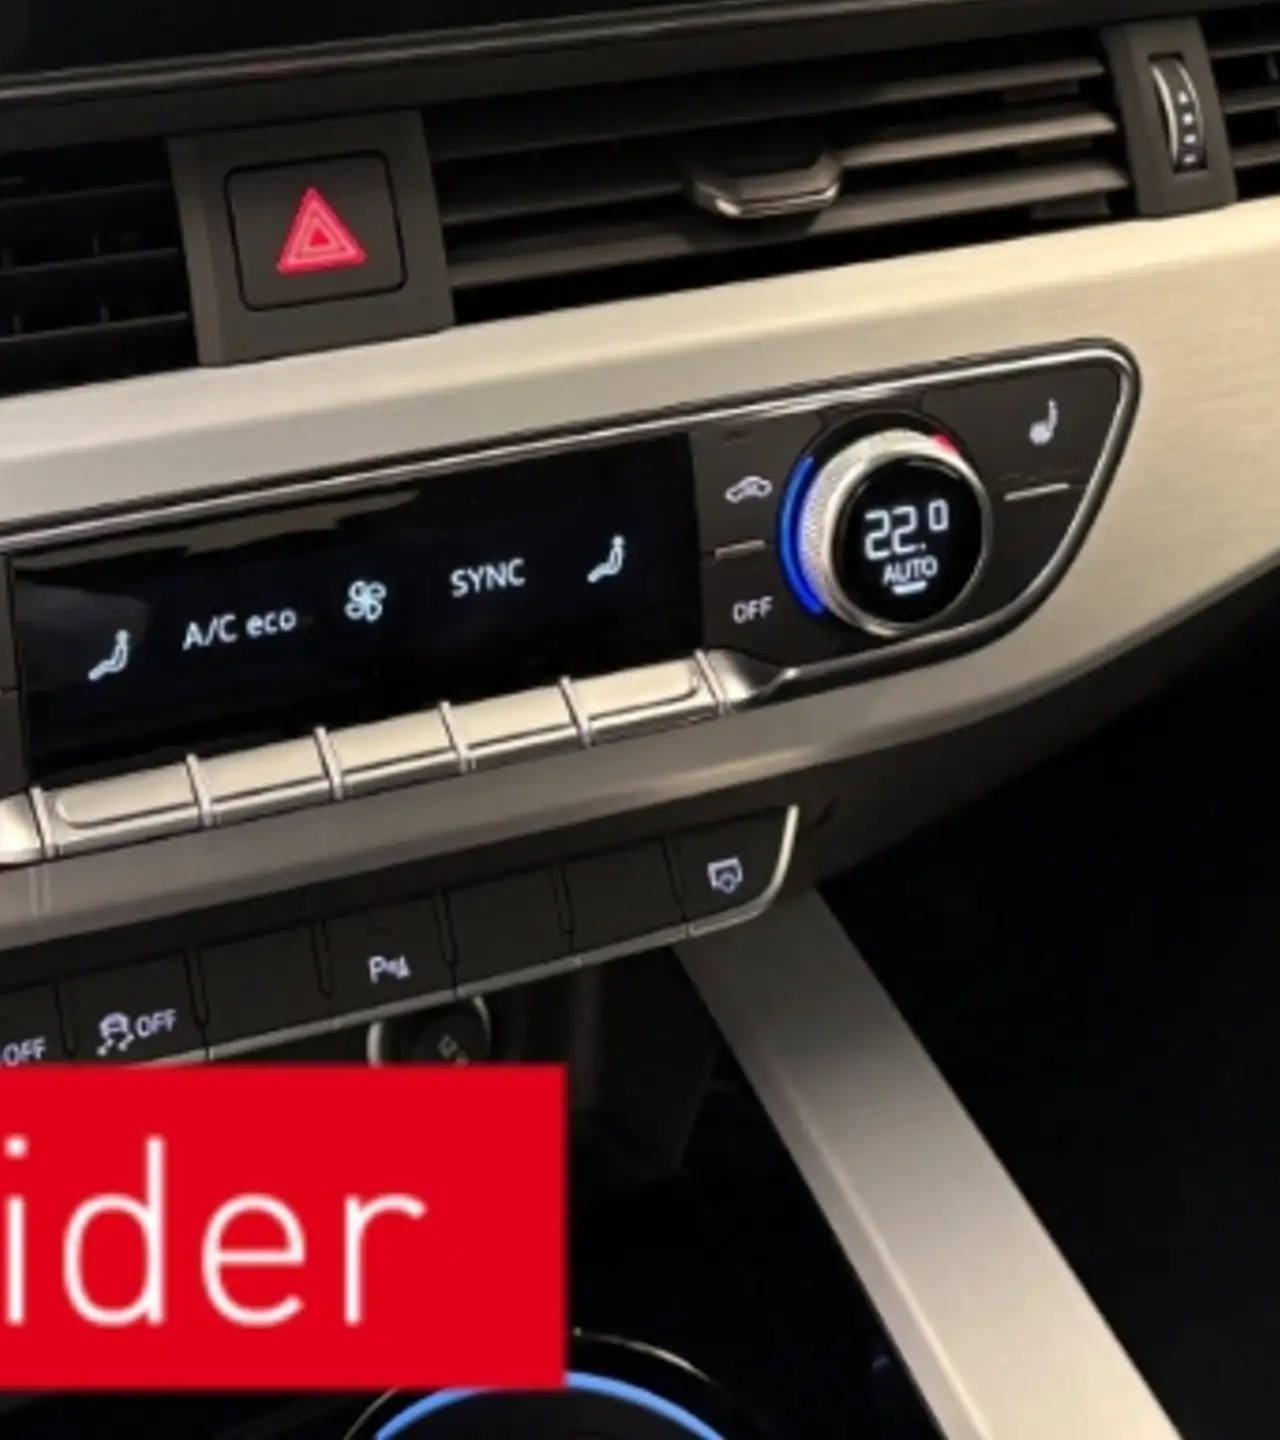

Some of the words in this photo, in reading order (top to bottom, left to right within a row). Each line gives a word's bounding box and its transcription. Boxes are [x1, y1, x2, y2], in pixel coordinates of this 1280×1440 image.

[449, 557, 527, 598] SYNC
[881, 555, 938, 586] AUTO
[731, 596, 774, 624] OFF
[182, 613, 239, 651] A/C
[245, 610, 297, 639] eco
[136, 1008, 178, 1040] OFF
[2, 1036, 46, 1068] OFF
